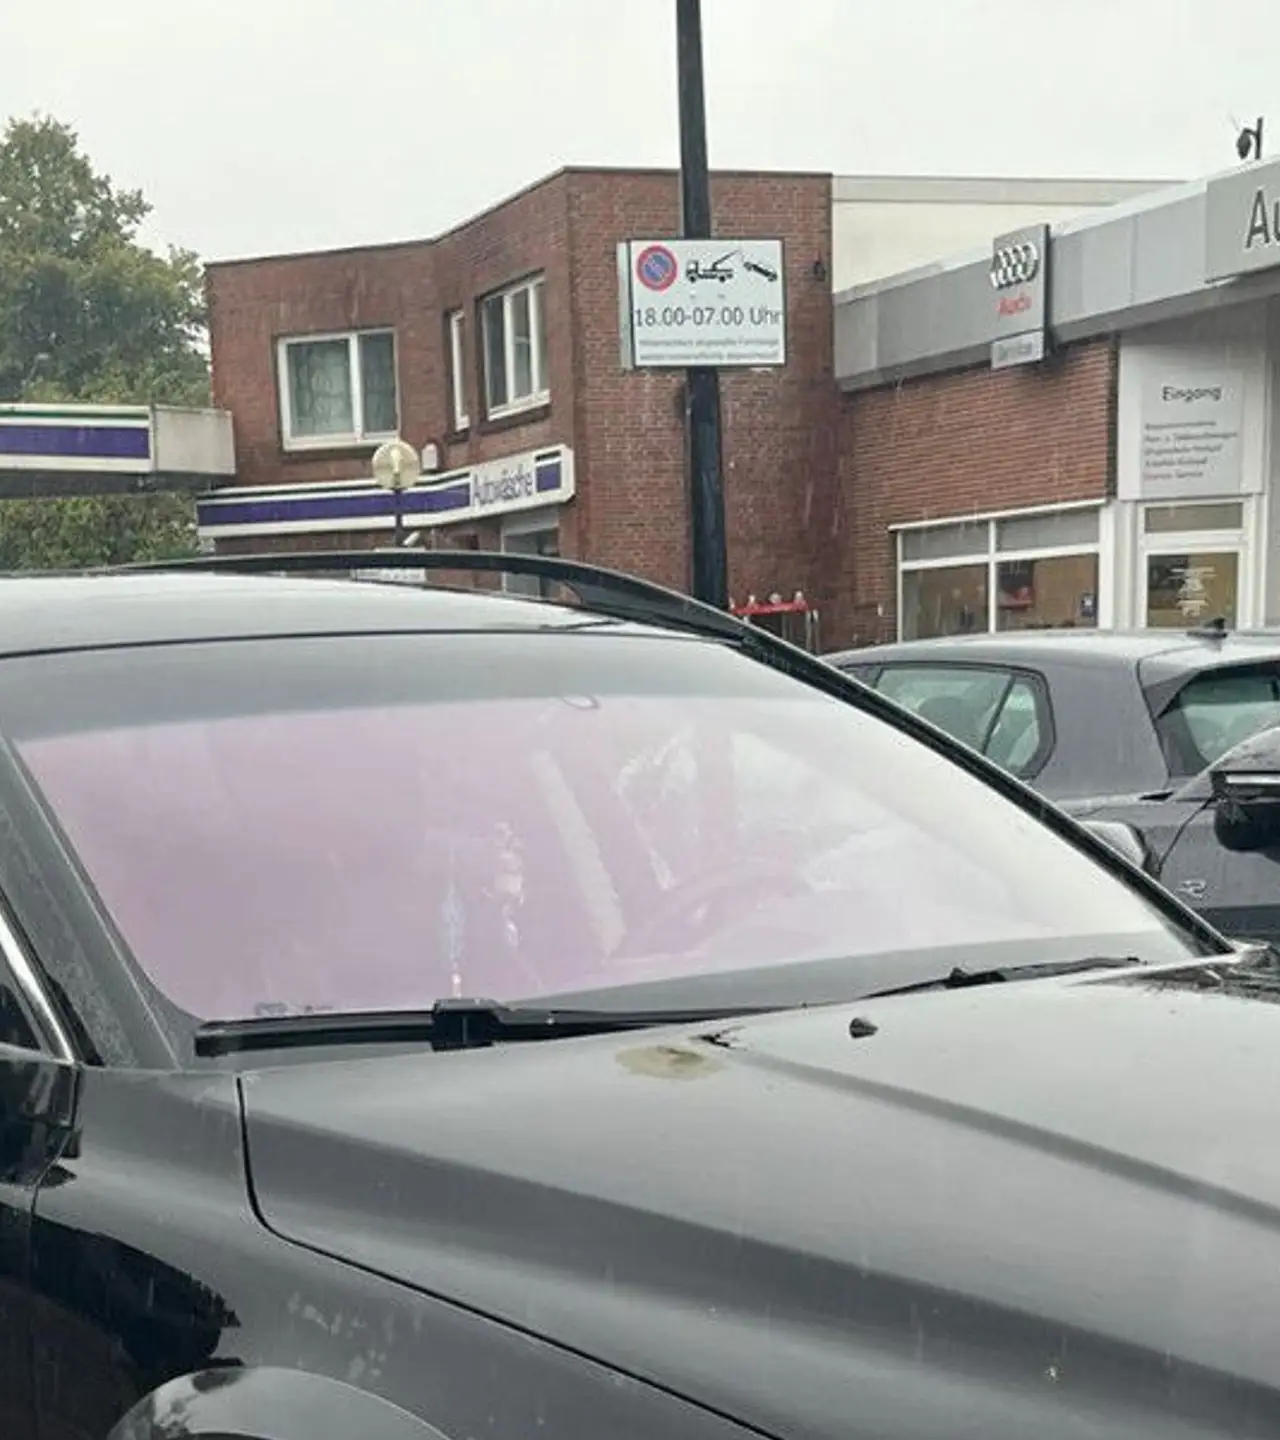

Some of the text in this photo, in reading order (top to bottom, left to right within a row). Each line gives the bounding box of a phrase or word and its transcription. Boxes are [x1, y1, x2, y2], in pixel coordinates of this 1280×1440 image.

[635, 306, 781, 327] 18.00-07.00 Uhr
[1163, 386, 1221, 402] Eingang
